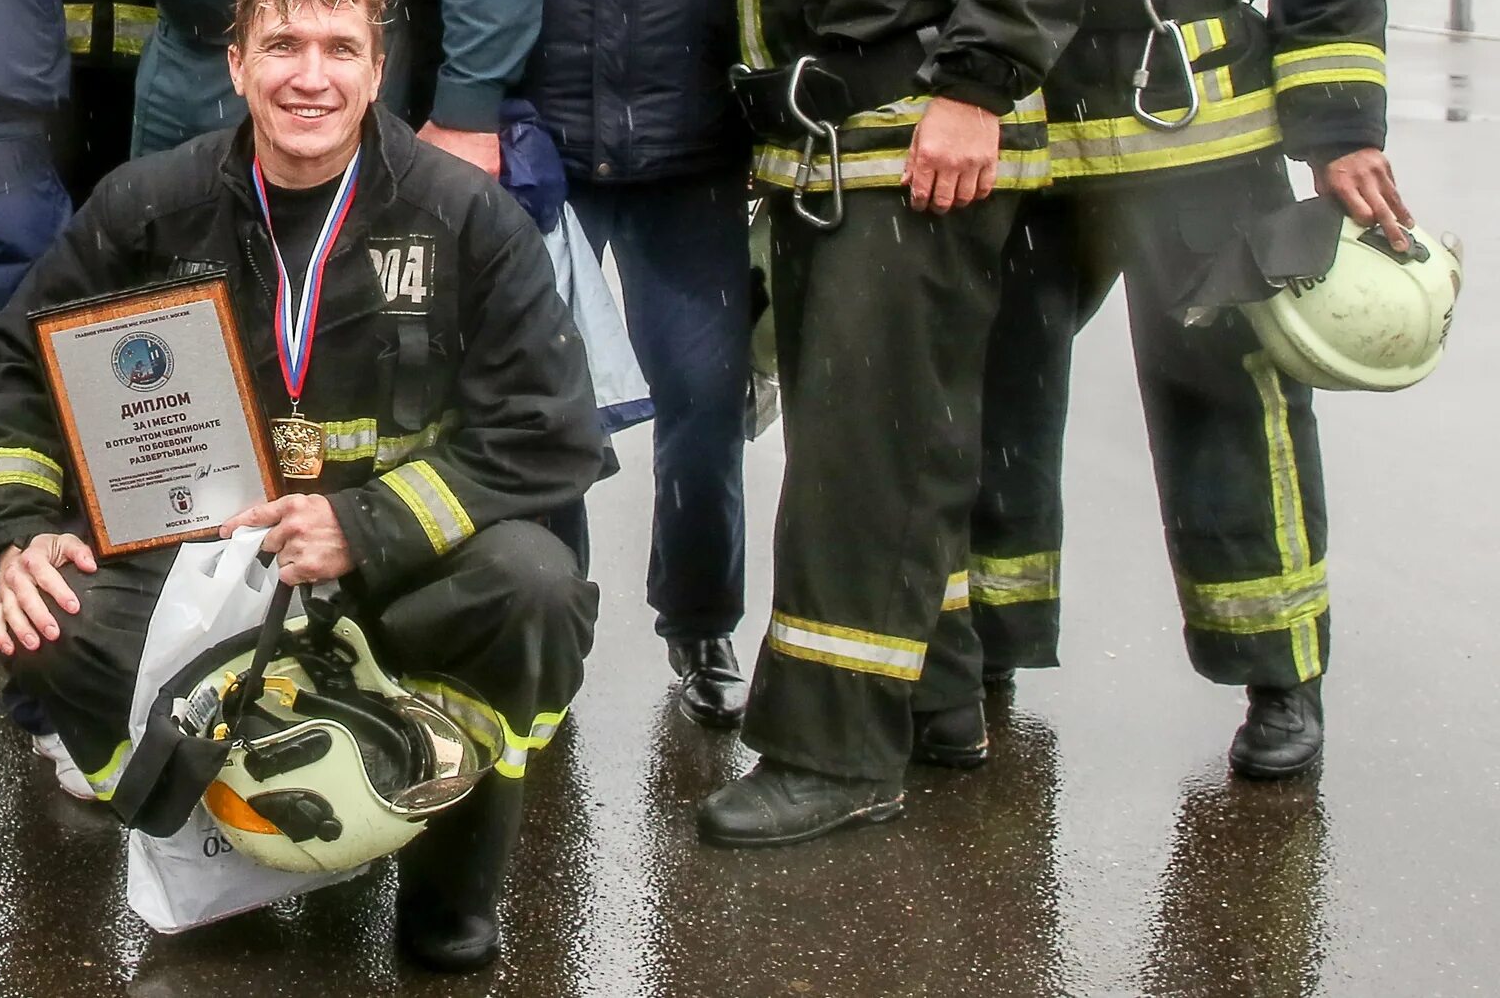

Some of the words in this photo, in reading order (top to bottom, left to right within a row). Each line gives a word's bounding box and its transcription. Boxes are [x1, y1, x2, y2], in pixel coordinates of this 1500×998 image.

[120, 392, 191, 420] ДИПЛОМ
[132, 420, 146, 431] ЗА
[152, 412, 187, 427] МЕСТО
[105, 441, 112, 449] В
[112, 431, 162, 448] ОТКРЫТОМ
[162, 419, 221, 436] ЧЕМПИОНАТЕ
[138, 443, 151, 453] ПО
[152, 436, 193, 450] БОЕВОМУ
[129, 443, 208, 465] РАЗВЕРТЫВАНИЮ
